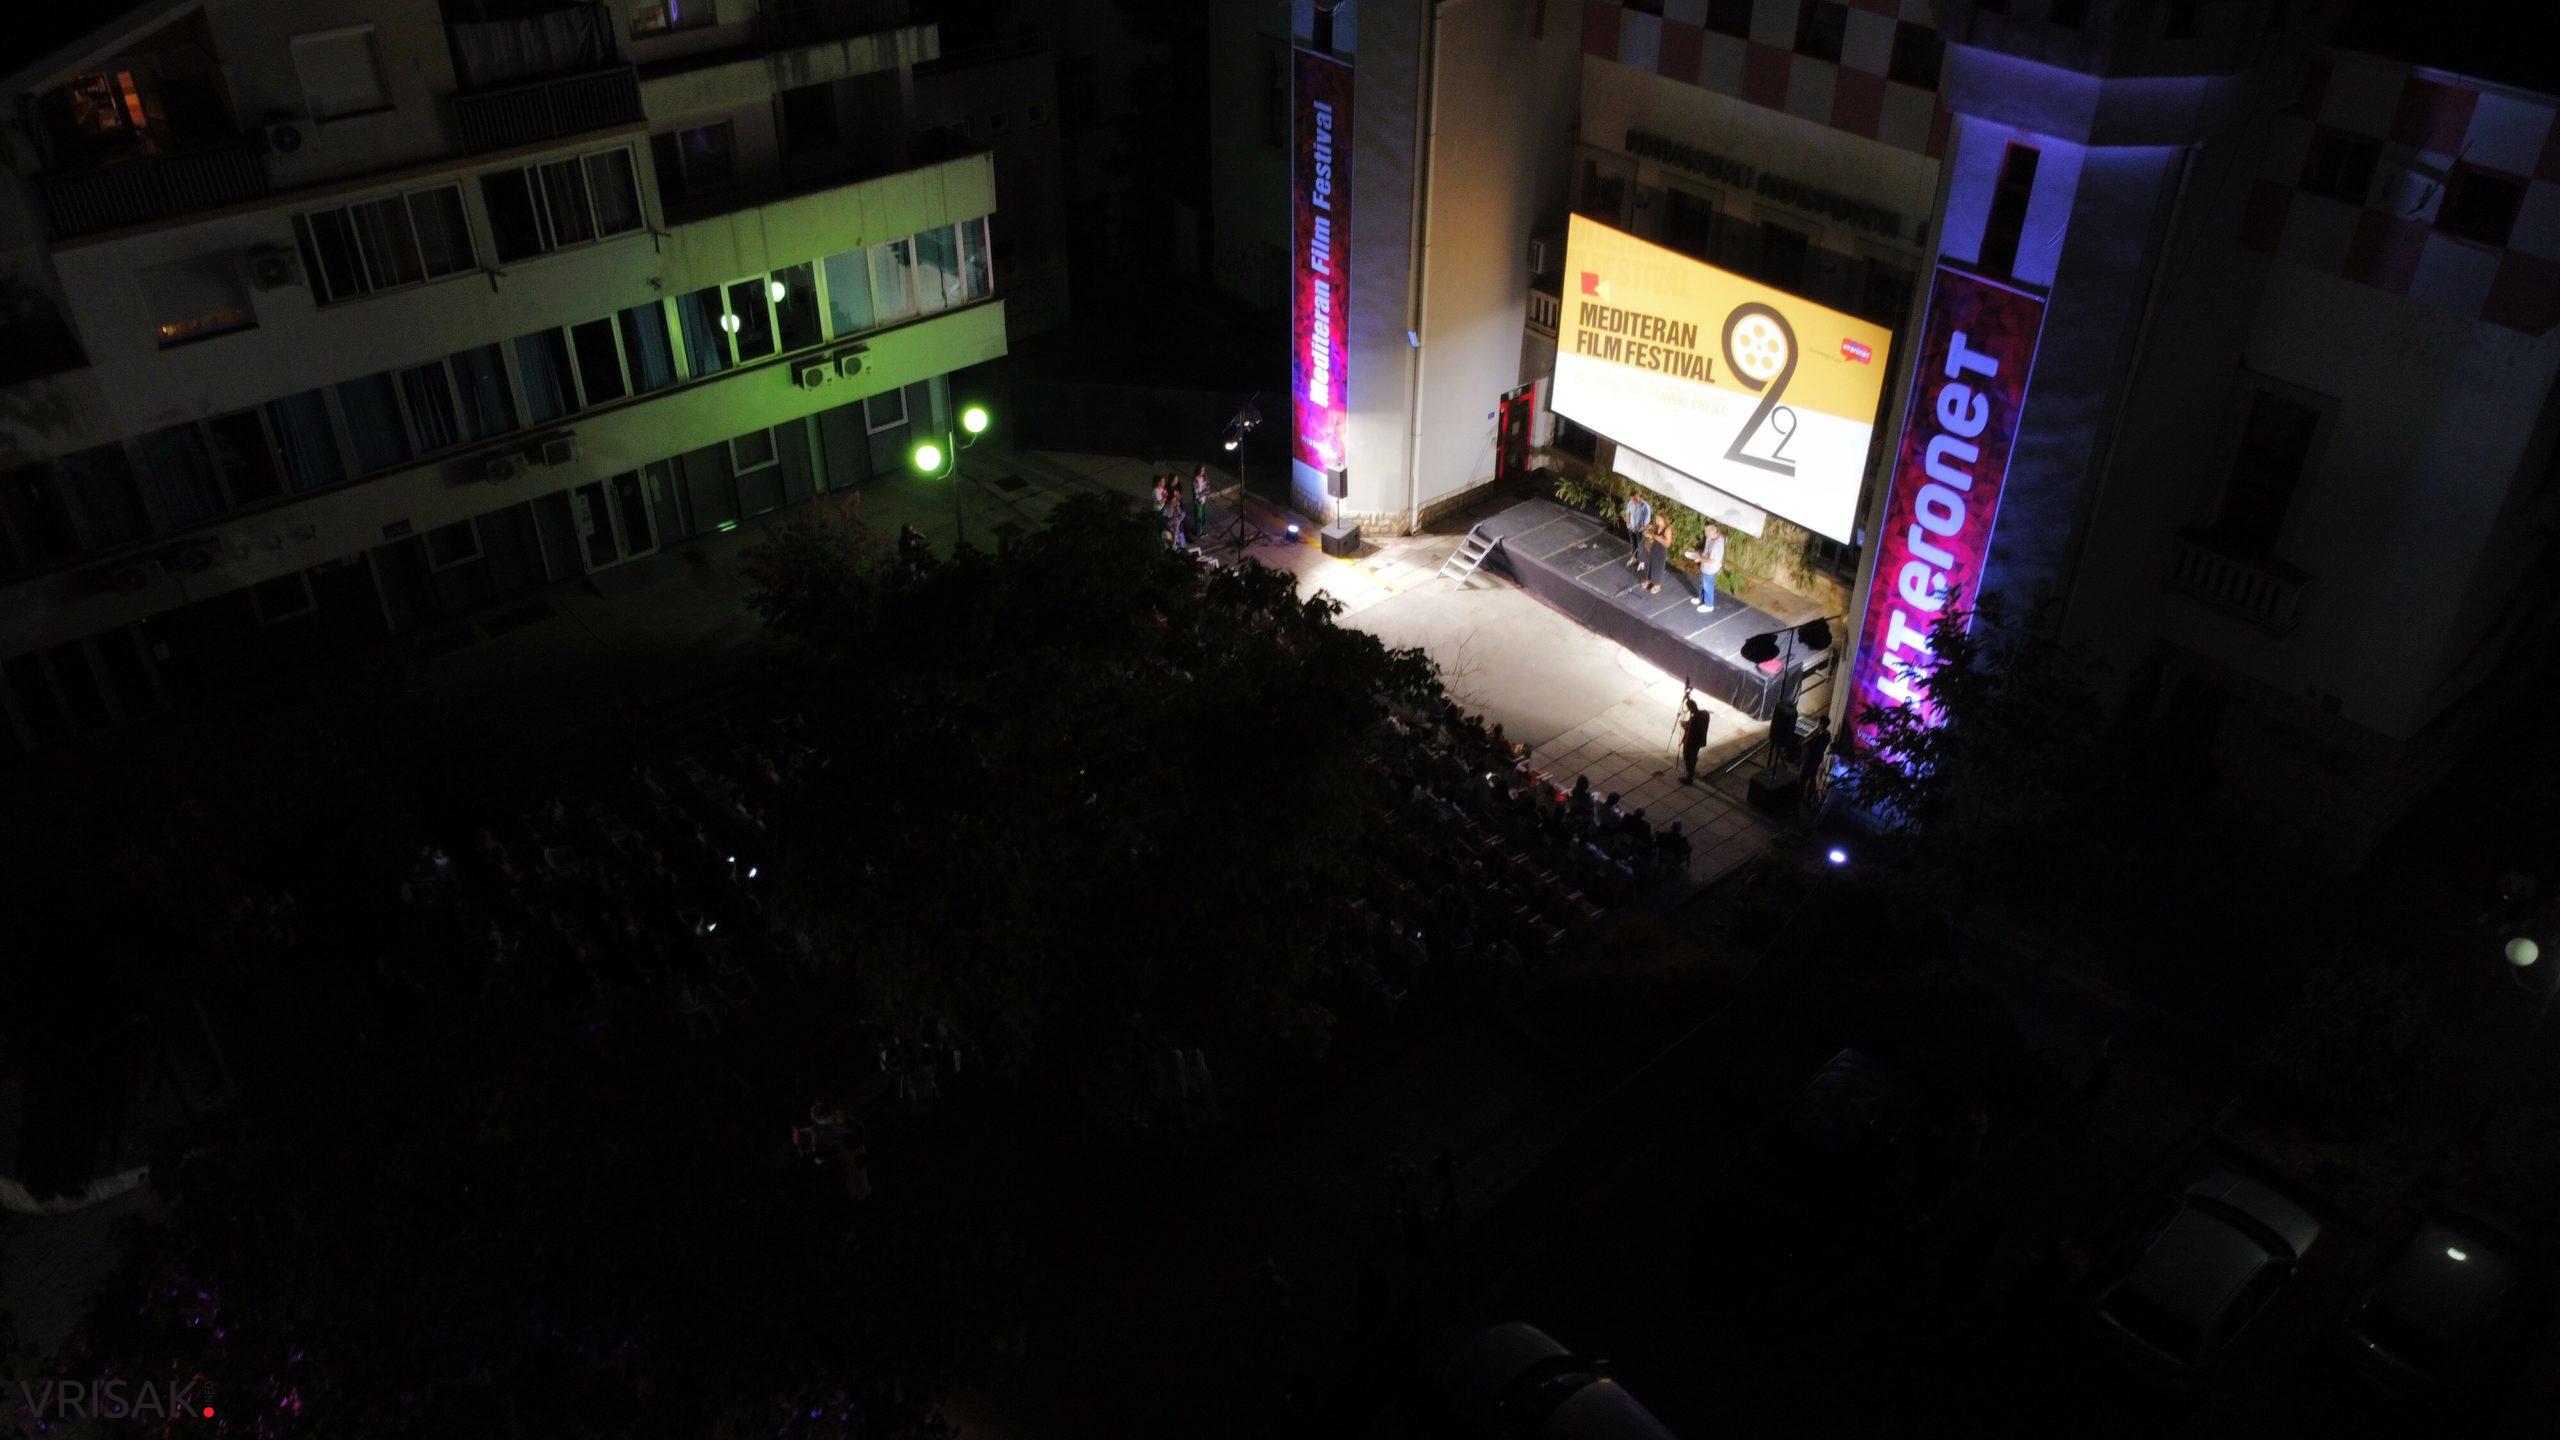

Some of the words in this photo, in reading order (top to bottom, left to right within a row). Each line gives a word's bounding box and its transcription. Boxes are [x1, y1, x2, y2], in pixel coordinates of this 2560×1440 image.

[1313, 100, 1332, 211] Festival
[1311, 215, 1331, 276] Film
[1310, 279, 1331, 408] Mediteran
[1579, 301, 1698, 350] MEDITERAN
[1576, 329, 1622, 362] FILM
[1625, 340, 1715, 384] FESTIVAL
